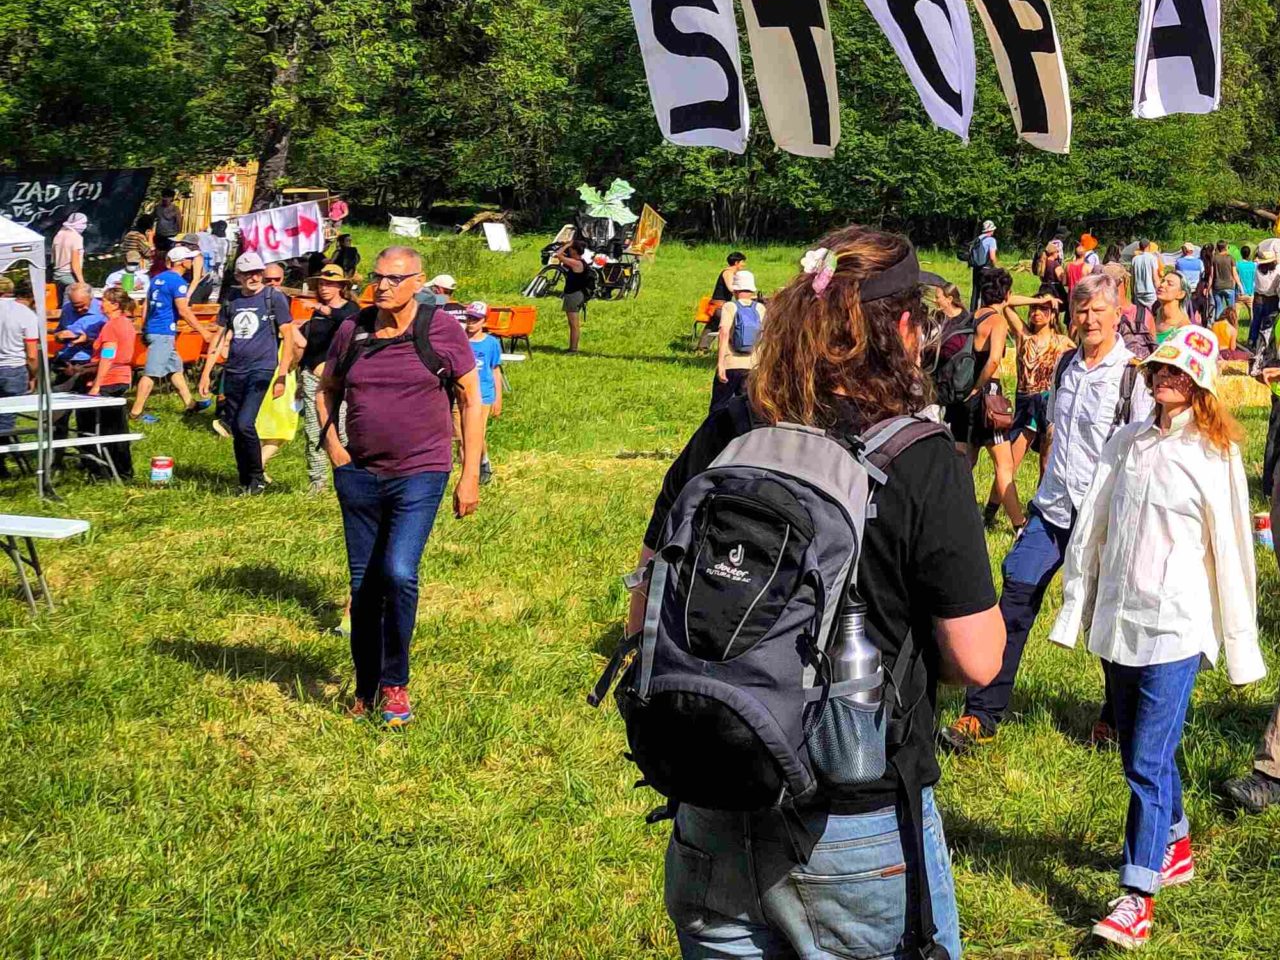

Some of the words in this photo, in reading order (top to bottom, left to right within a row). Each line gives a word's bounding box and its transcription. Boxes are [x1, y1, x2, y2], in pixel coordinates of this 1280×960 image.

[11, 181, 62, 203] ZAD
[68, 180, 103, 202] (?!)
[240, 220, 281, 252] WC
[714, 563, 749, 577] deuter
